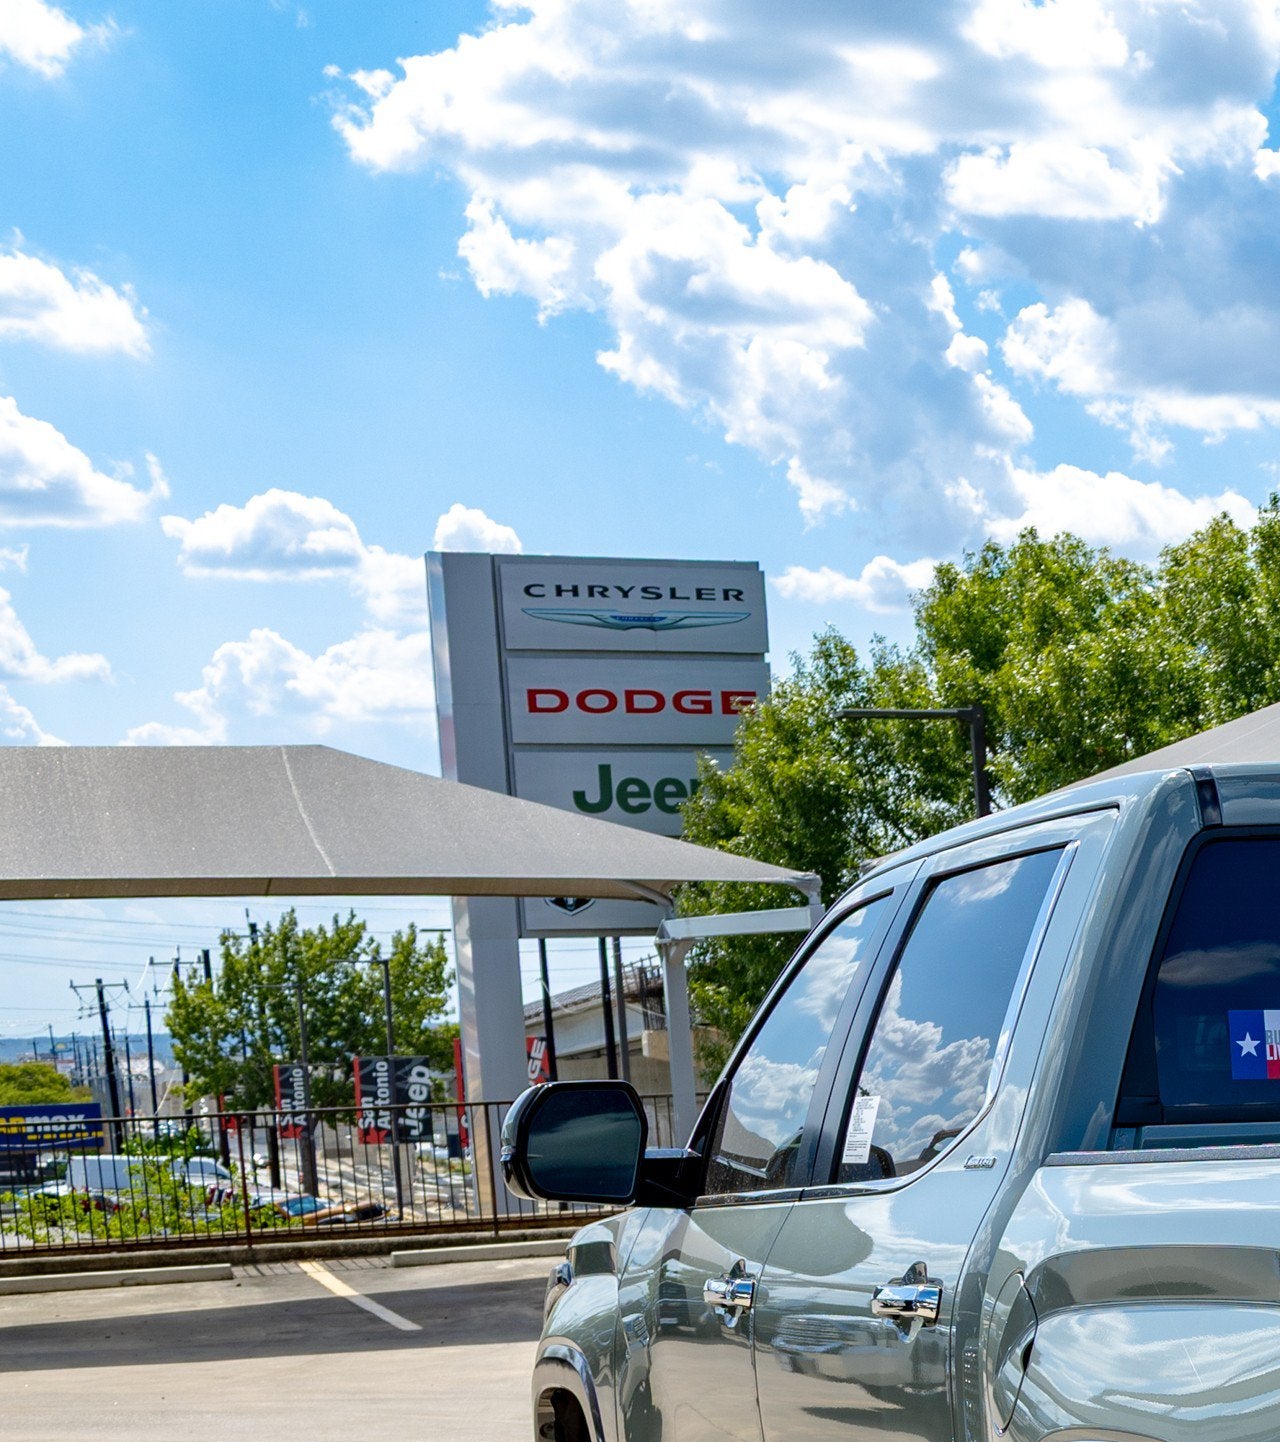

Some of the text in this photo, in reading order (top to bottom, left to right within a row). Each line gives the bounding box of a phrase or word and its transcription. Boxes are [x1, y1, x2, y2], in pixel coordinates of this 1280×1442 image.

[523, 583, 745, 603] CHRYSLER
[526, 688, 758, 716] DODGE
[572, 764, 703, 815] Jee
[280, 1099, 291, 1127] Sn
[398, 1065, 433, 1136] Jeep
